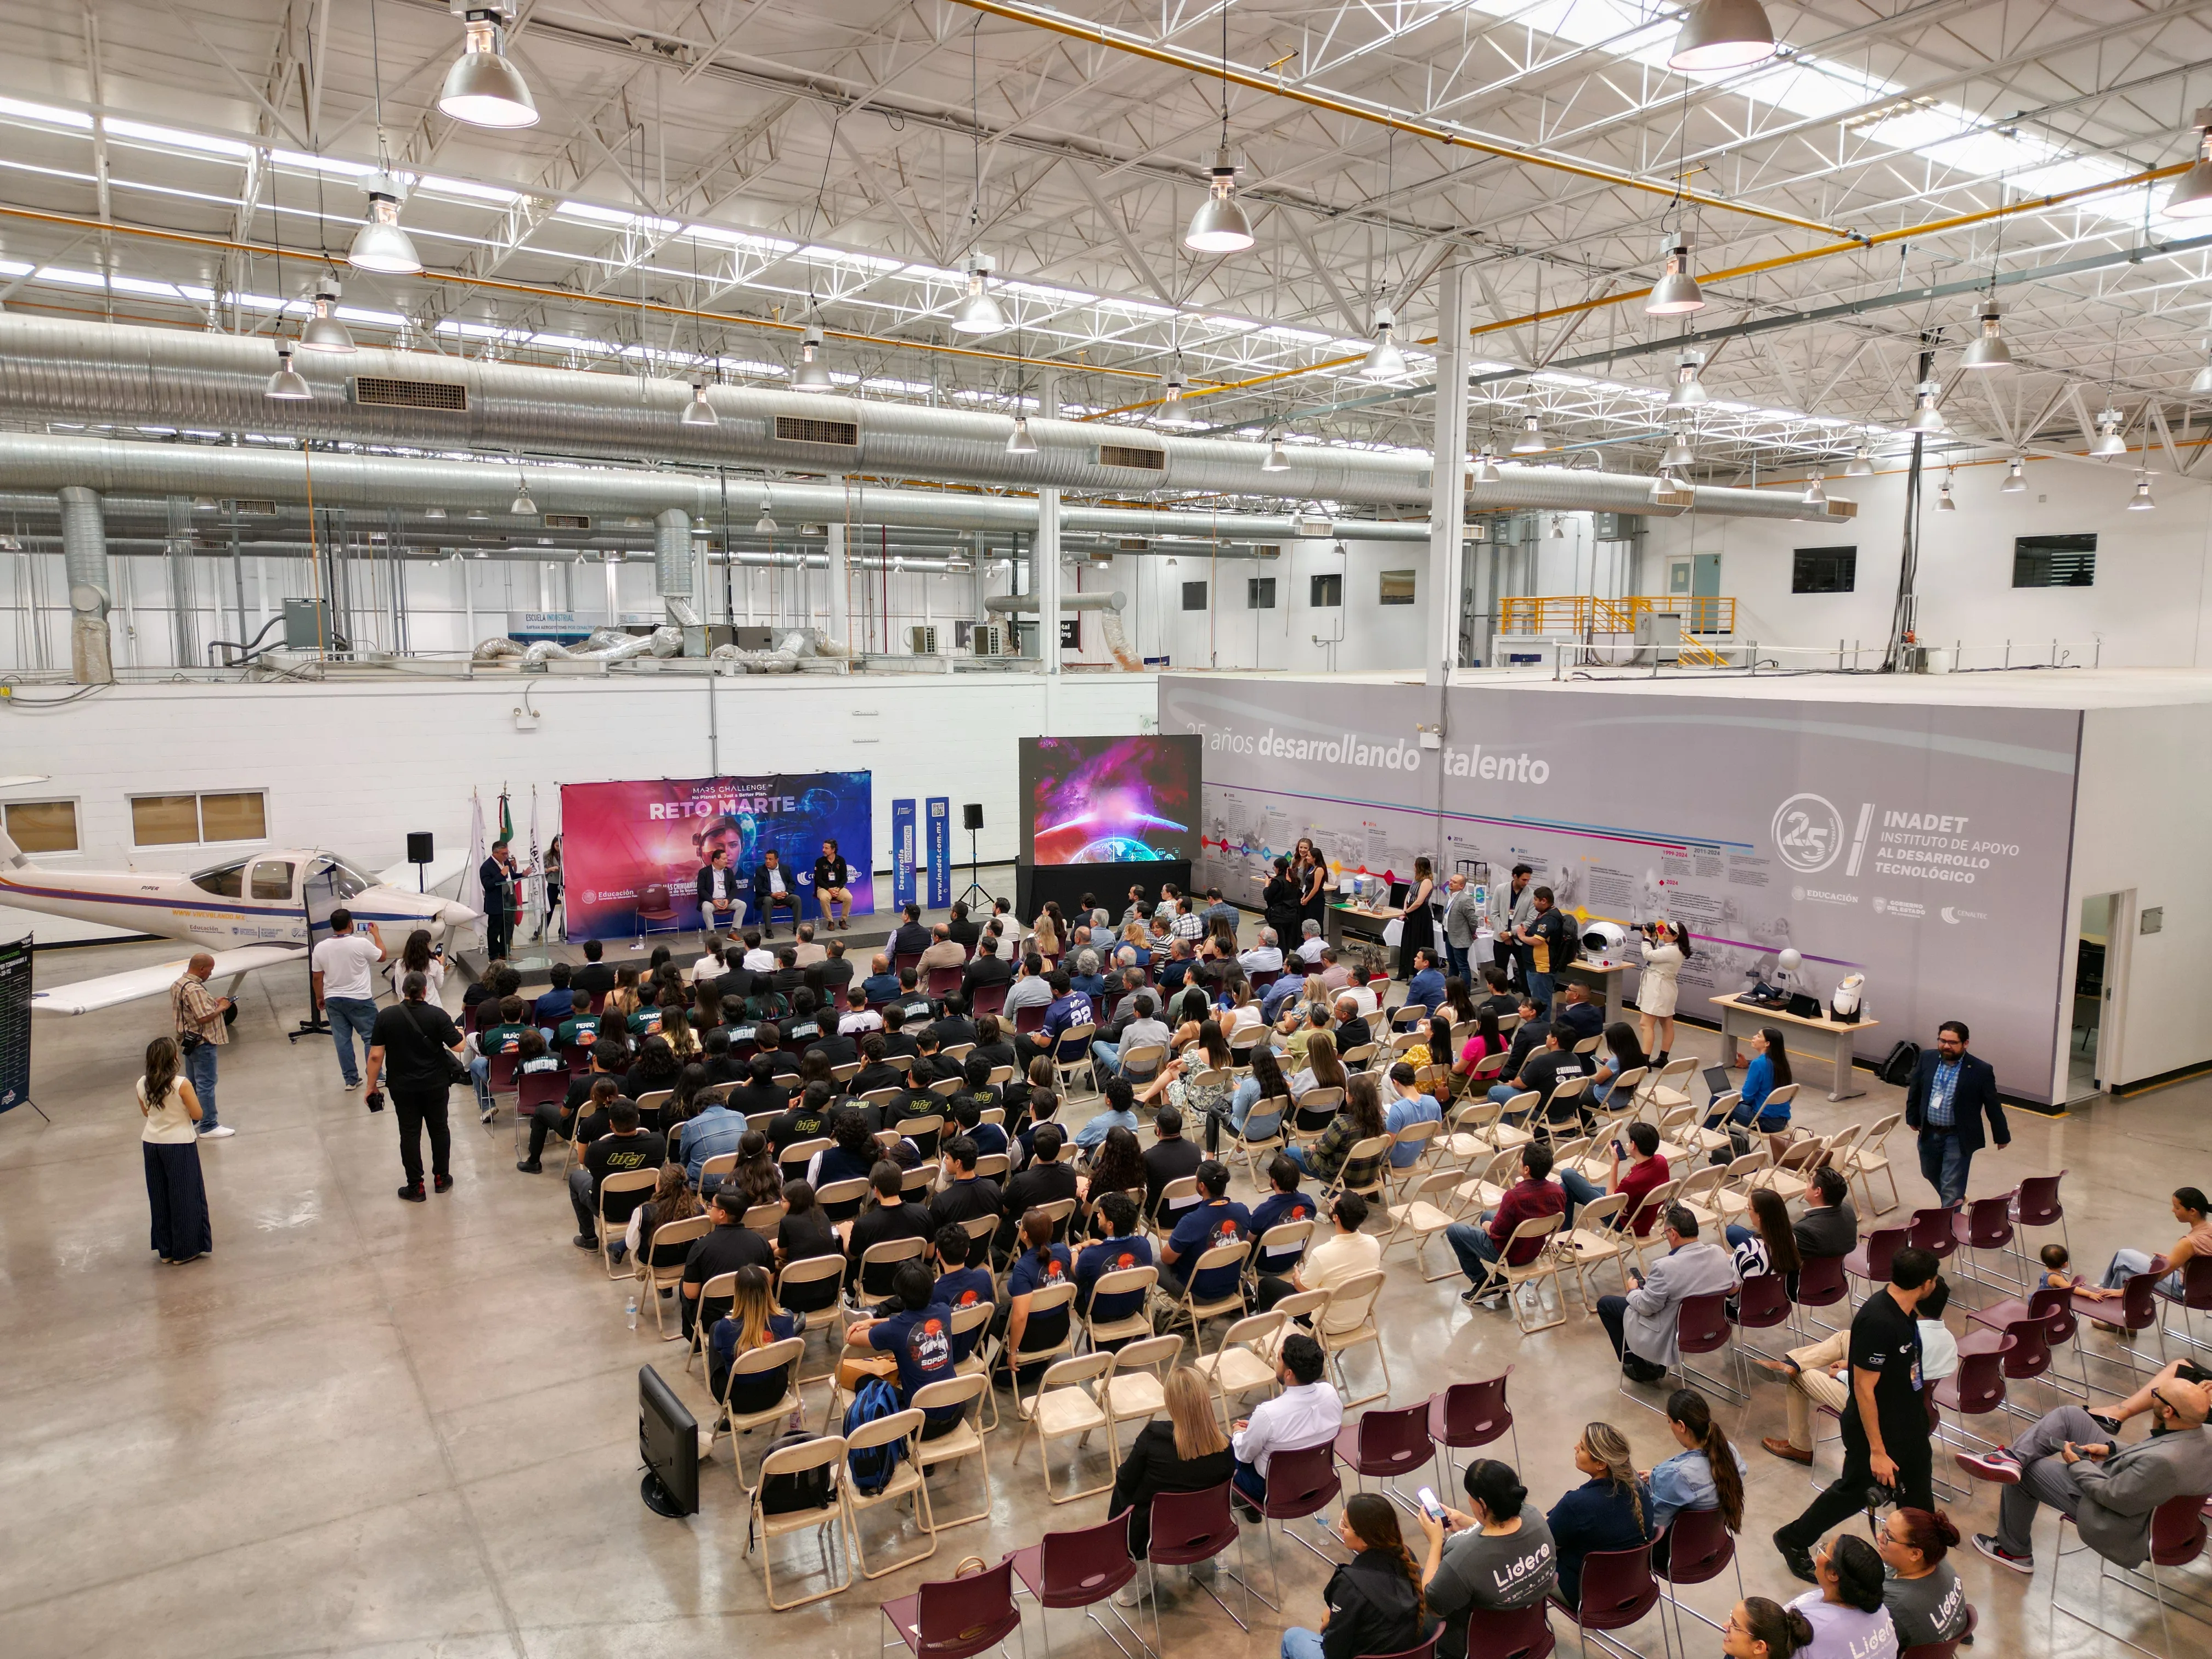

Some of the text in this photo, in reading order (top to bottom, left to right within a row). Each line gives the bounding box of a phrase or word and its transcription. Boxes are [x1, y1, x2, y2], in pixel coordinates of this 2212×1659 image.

[1211, 726, 1254, 754] años
[1259, 727, 1420, 771] desarrollando
[1443, 744, 1550, 785] talento
[650, 796, 796, 820] RETO MARTE
[1883, 810, 1968, 833] INADET
[1782, 811, 1828, 862] 25
[1880, 831, 2019, 856] INSTITUTO DE APOYO
[1694, 848, 1720, 856] 2011-2024
[1877, 847, 1990, 869] AL DESARROLLO
[1875, 862, 1975, 883] TECNOLÓGICO
[599, 889, 634, 898] Educación
[1807, 889, 1859, 903] EDUCACIÓN
[1890, 900, 1923, 909] GOBIERNO
[1900, 906, 1926, 915] ESTADO
[1071, 1006, 1093, 1028] 22
